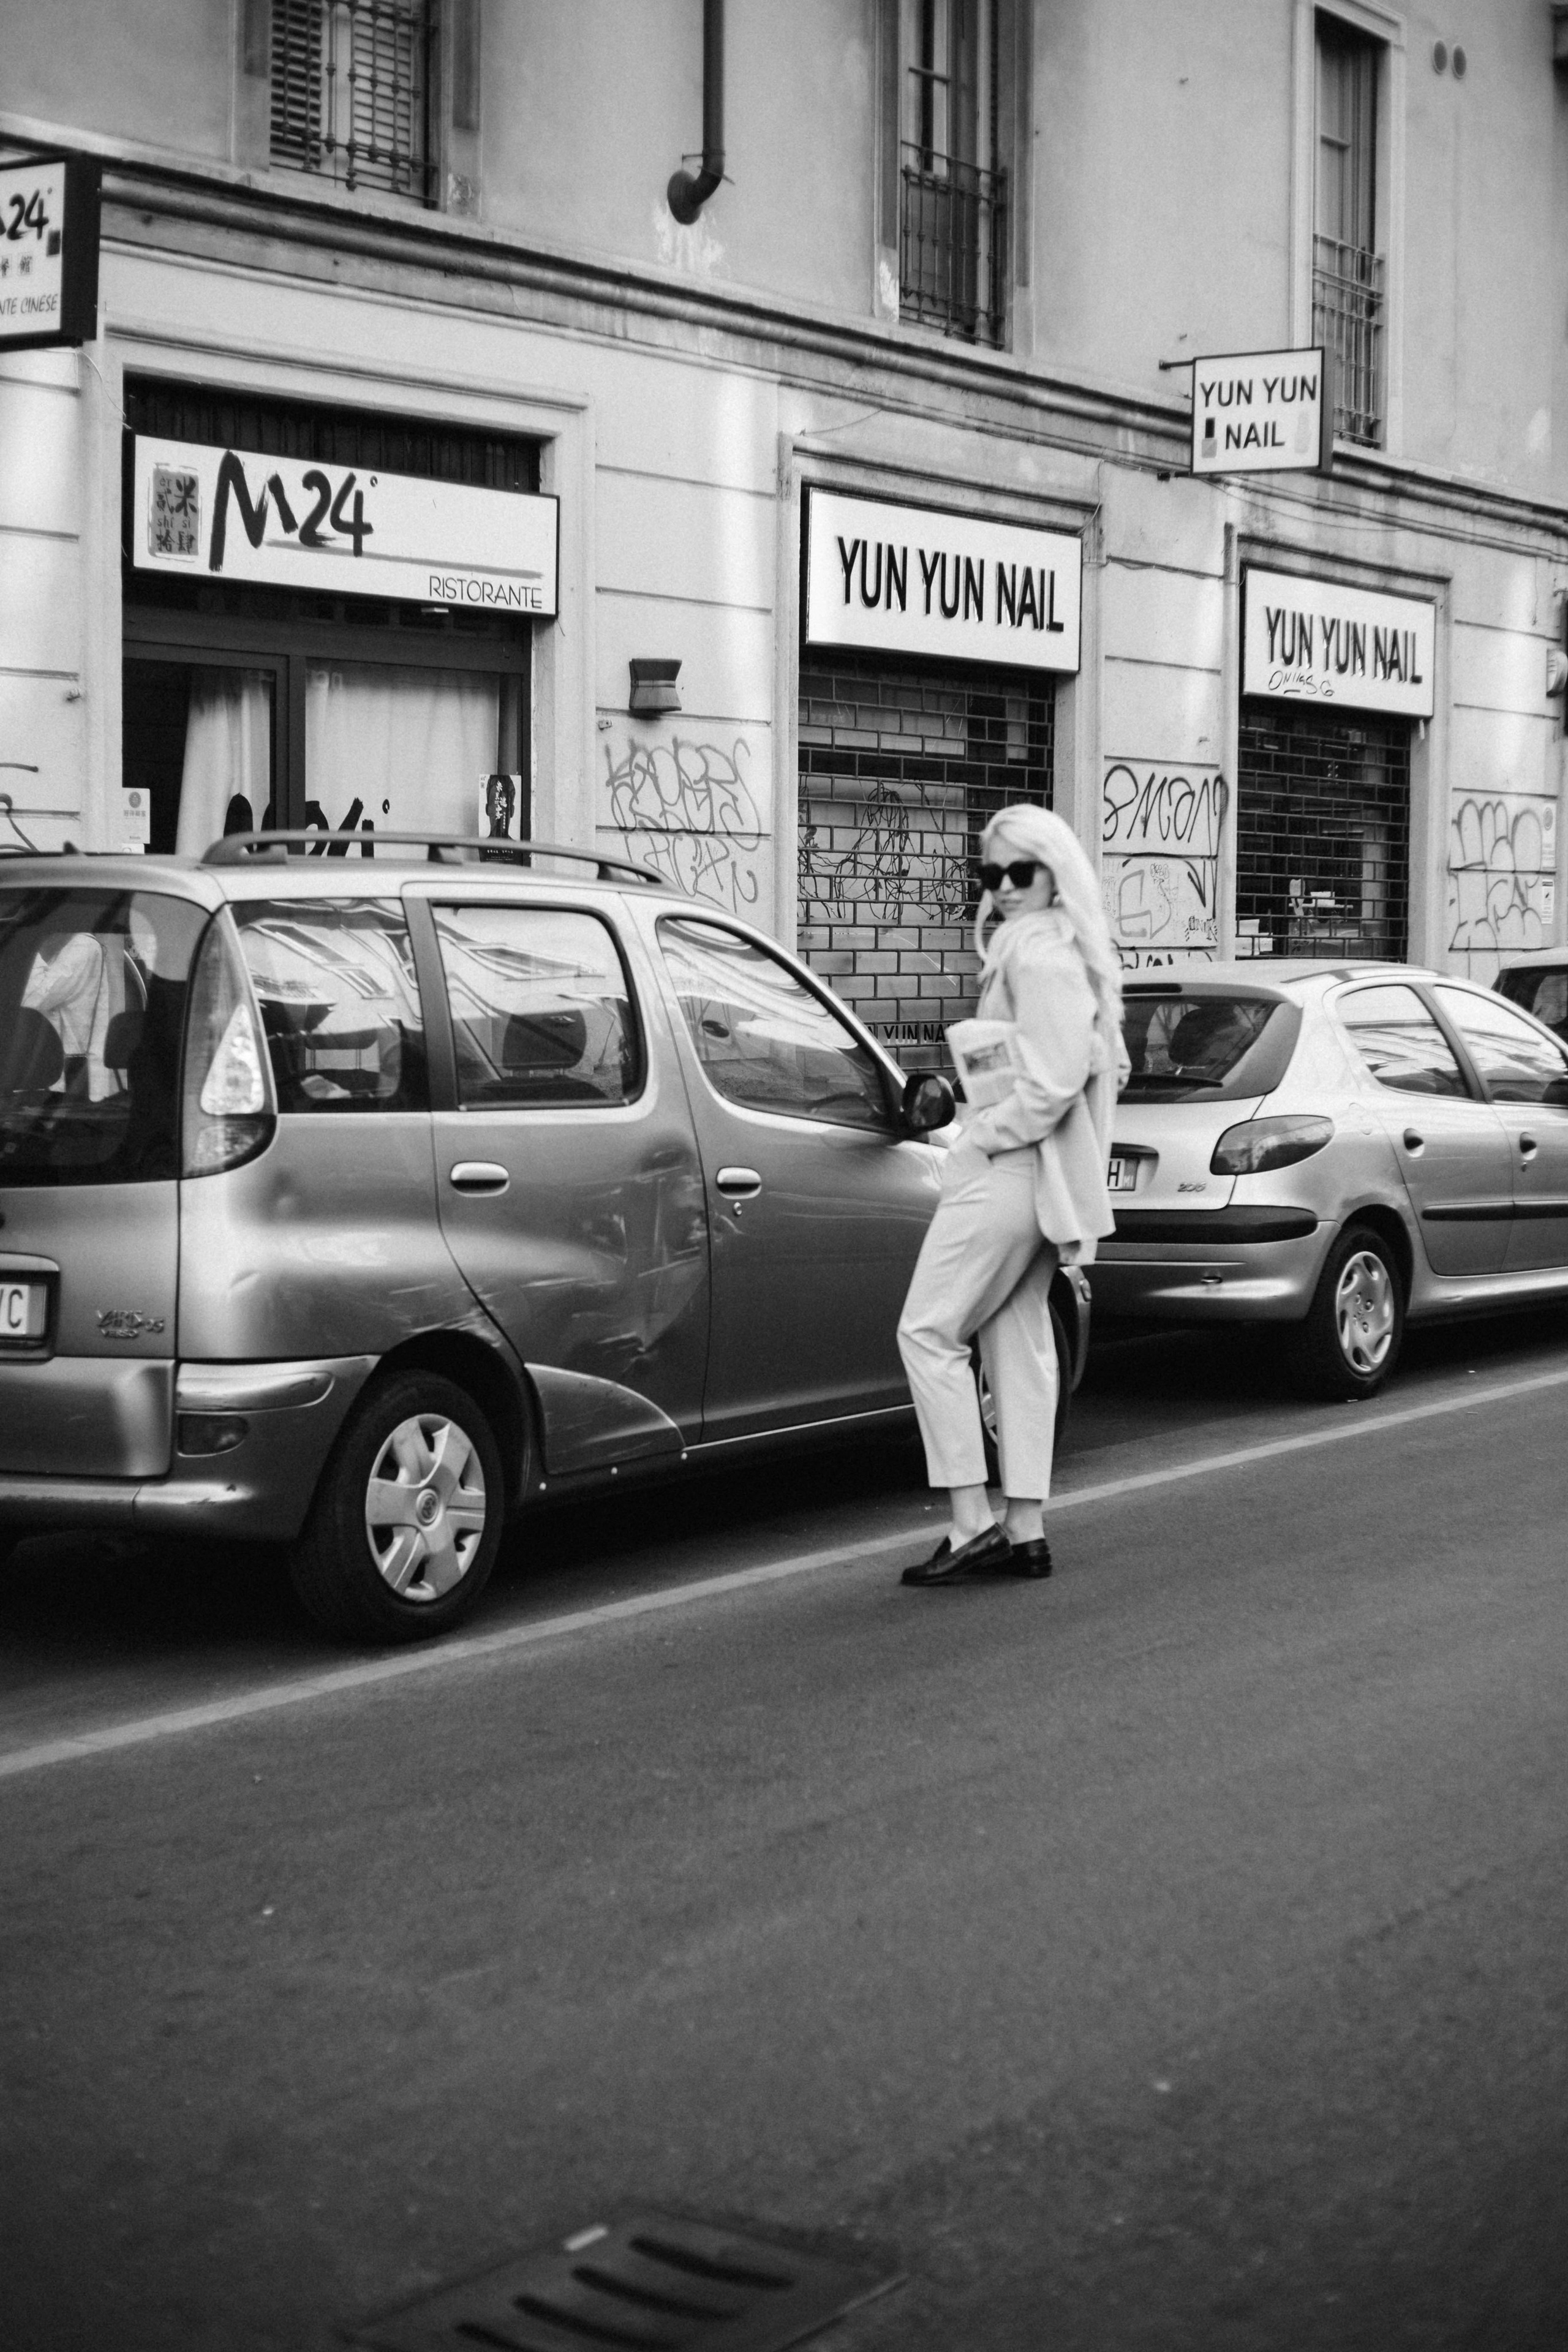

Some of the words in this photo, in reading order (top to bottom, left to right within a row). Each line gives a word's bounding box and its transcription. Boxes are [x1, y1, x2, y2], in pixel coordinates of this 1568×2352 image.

[21, 293, 58, 314] CINESE
[1200, 379, 1253, 408] YUN
[1262, 374, 1317, 404] YUN
[1226, 420, 1285, 450] NAIL
[429, 576, 542, 609] RISTORANTE
[837, 535, 908, 612] YUN
[918, 548, 984, 622] YUN
[996, 561, 1064, 632] NAIL
[1265, 606, 1313, 668] YUN
[1321, 616, 1366, 677] YUN
[1374, 625, 1422, 684] NAIL
[884, 1024, 918, 1044] YUN
[1177, 1182, 1206, 1193] 206
